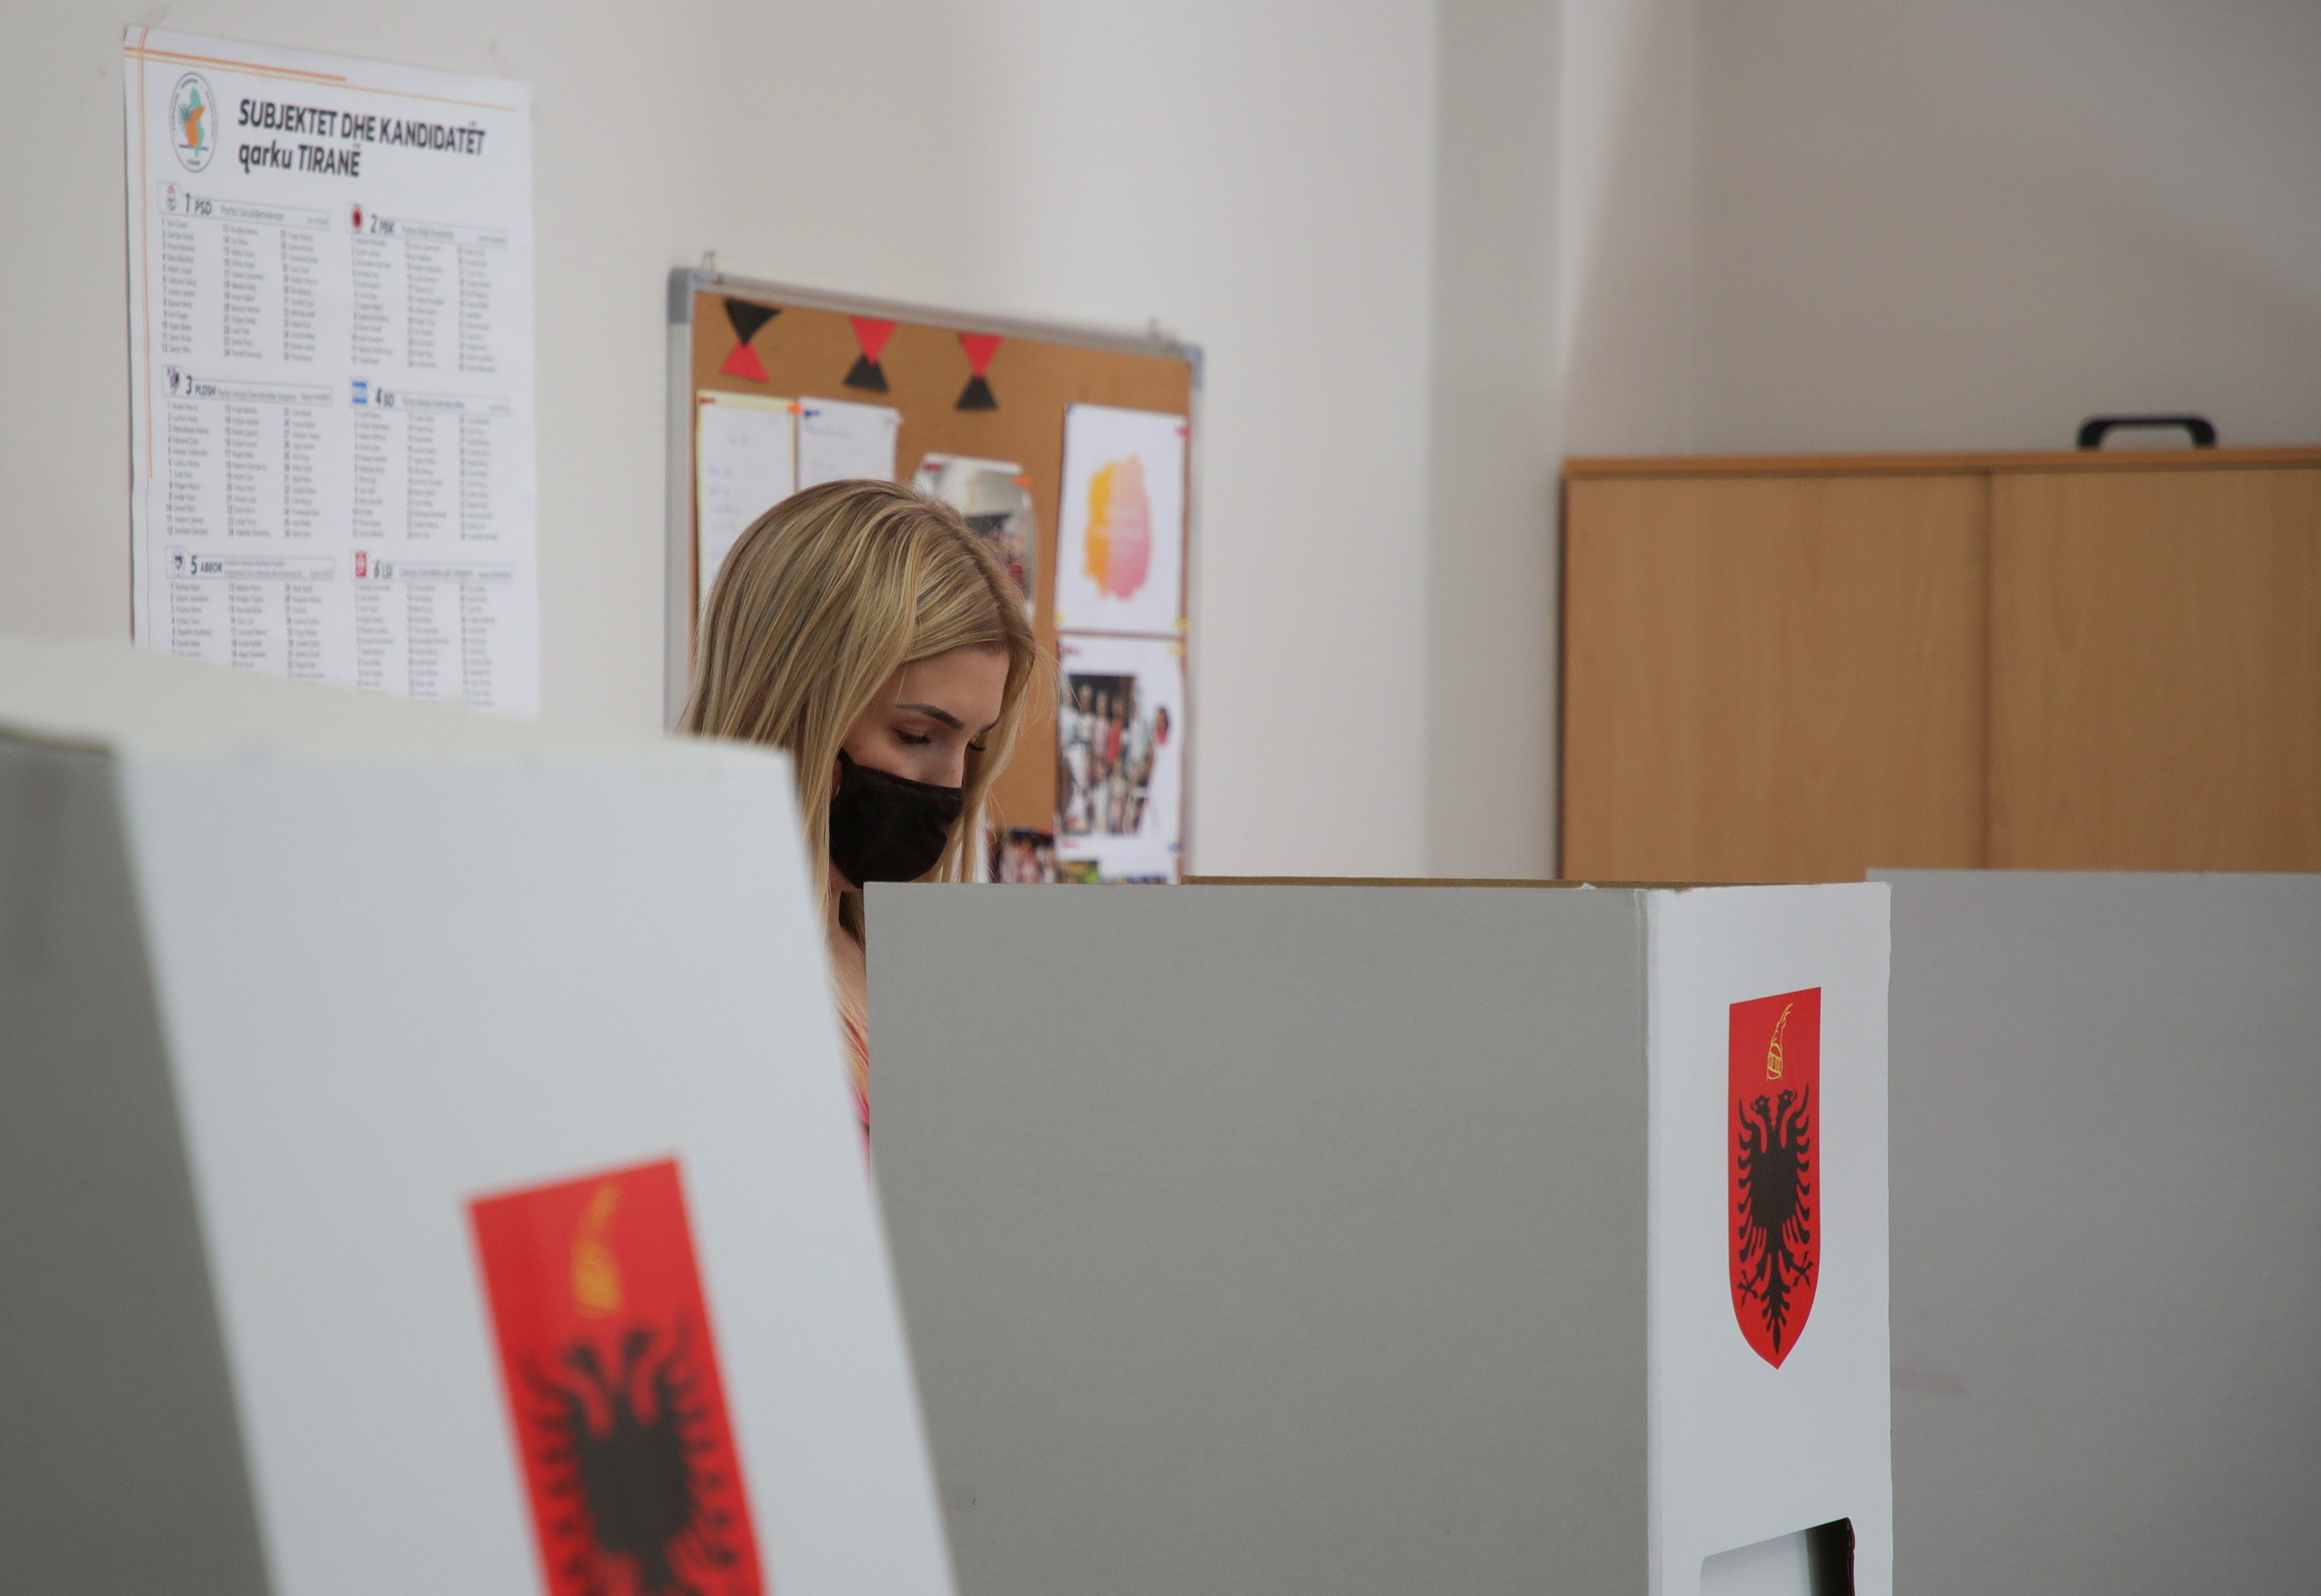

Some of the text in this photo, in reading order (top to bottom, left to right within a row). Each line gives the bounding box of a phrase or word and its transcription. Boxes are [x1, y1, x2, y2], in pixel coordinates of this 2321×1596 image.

[237, 98, 337, 137] SUBJEKTET
[341, 113, 376, 142] DHE
[379, 118, 486, 155] KANDIDATËT
[238, 140, 361, 177] qarku TIRANË
[185, 193, 190, 214] 1
[194, 200, 212, 216] PSD
[370, 213, 378, 234] 2
[186, 375, 192, 395] 3
[375, 387, 381, 407] 4
[191, 555, 197, 576] 5
[374, 560, 379, 580] 6
